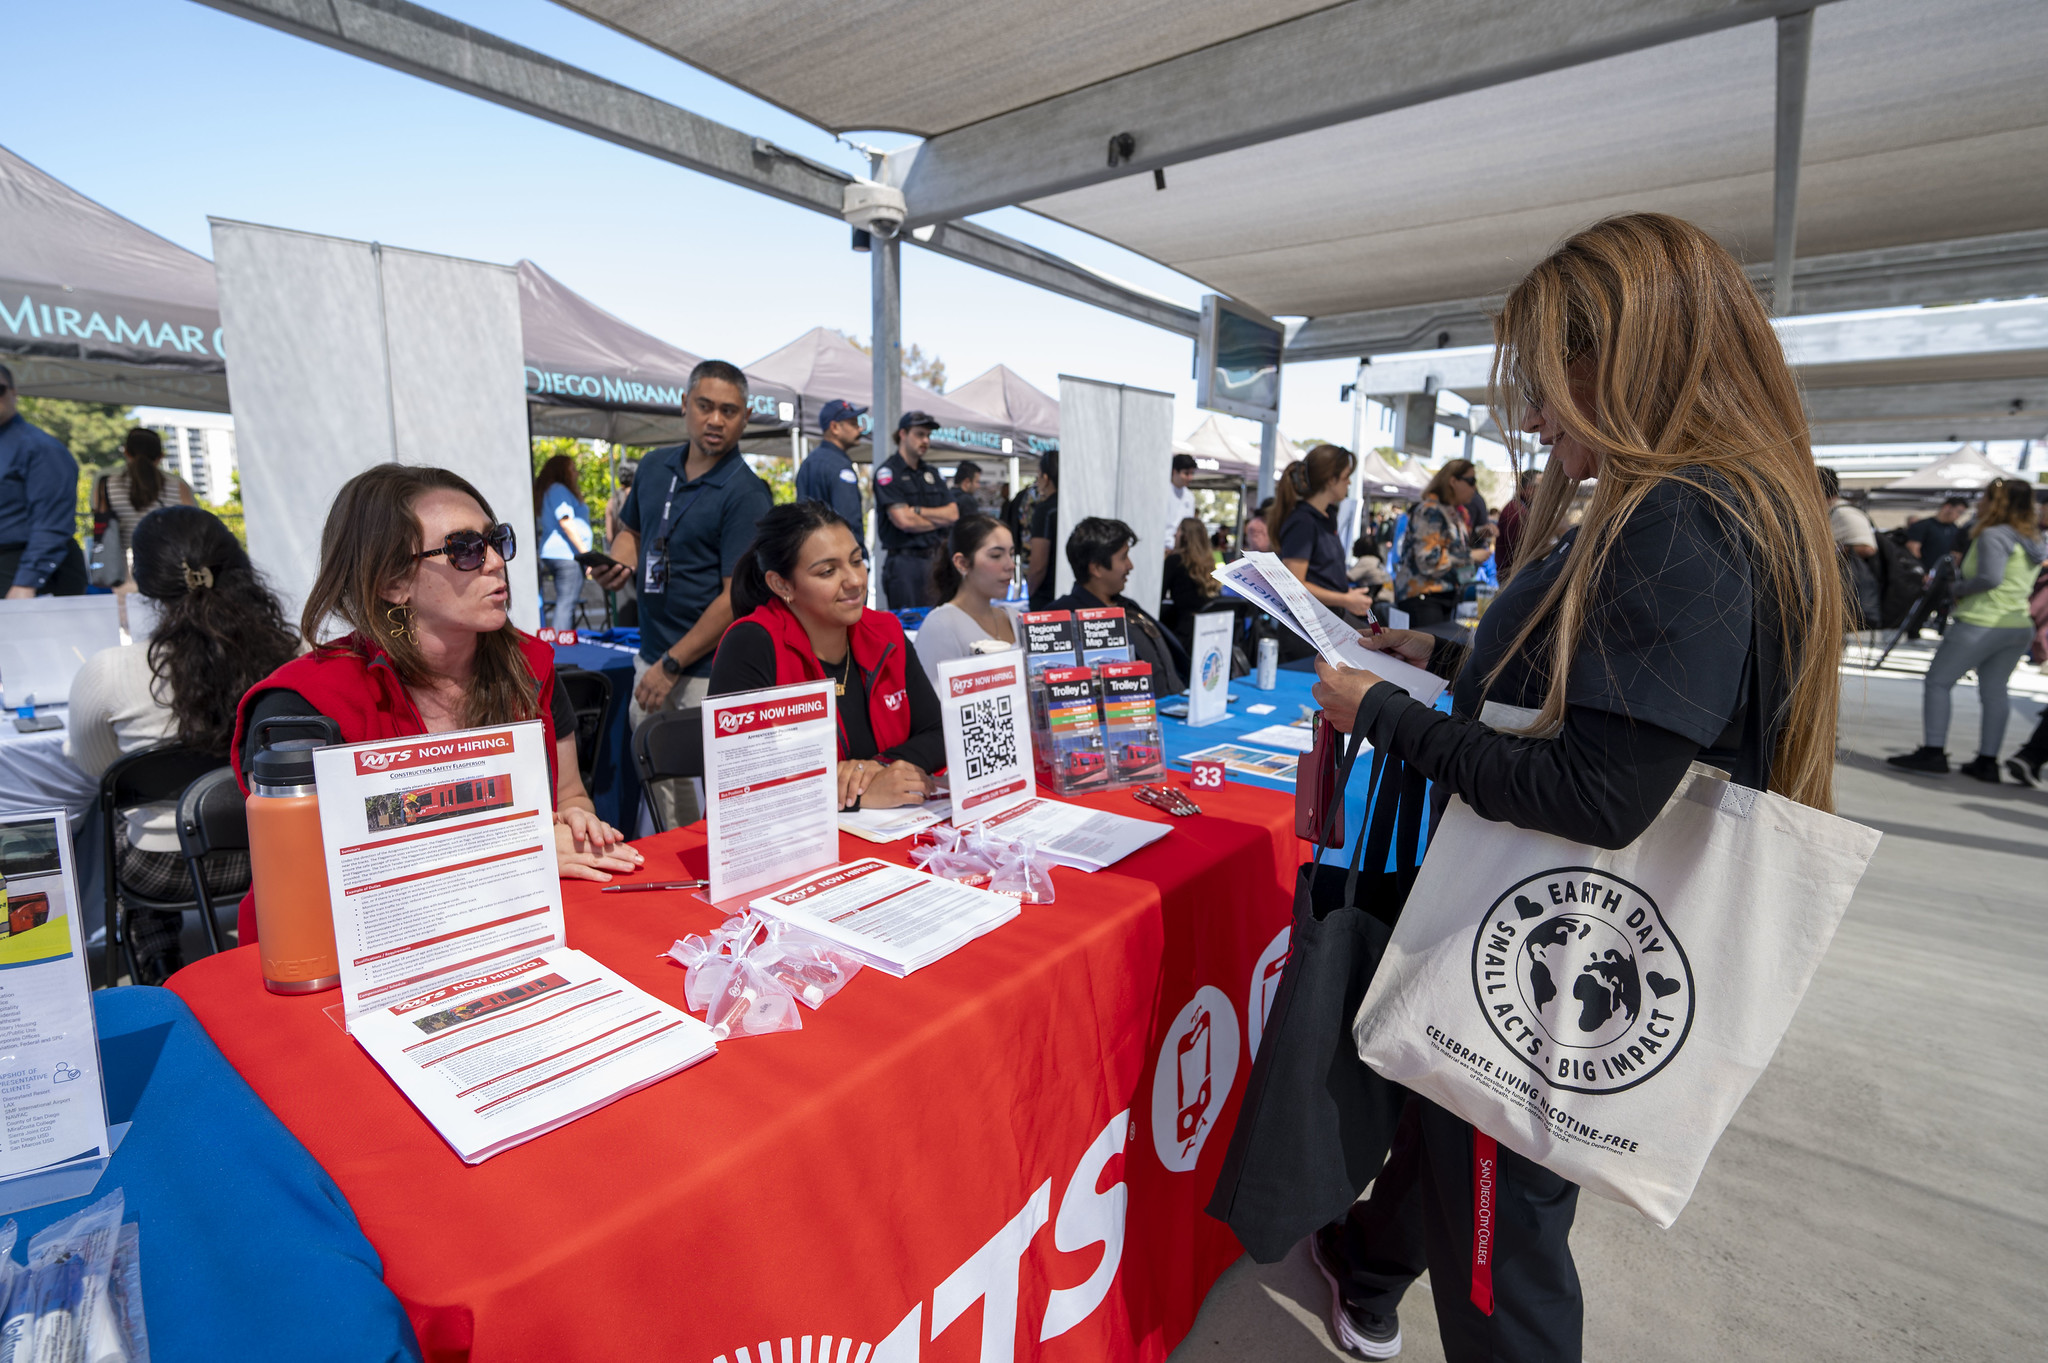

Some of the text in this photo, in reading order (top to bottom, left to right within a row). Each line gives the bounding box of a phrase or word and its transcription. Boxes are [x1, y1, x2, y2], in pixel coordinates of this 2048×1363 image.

[0, 294, 209, 355] MIRAMAR
[524, 366, 685, 405] DIEGO MIRAMA
[957, 425, 1001, 449] COLLEGE
[1028, 623, 1062, 634] Regional
[1083, 619, 1116, 630] Regional
[1084, 629, 1109, 639] Transit
[558, 632, 574, 645] 65
[1029, 633, 1056, 643] Transit
[1031, 642, 1049, 652] Map
[1085, 638, 1103, 647] Map
[975, 676, 990, 686] NOW
[1051, 685, 1080, 697] Trolley
[1110, 680, 1139, 692] Trolley
[719, 700, 824, 730] MTS NOW HIRING.
[361, 737, 509, 768] MTS NOW HIRING.
[389, 760, 486, 779] CONSTRUCTION SAFETY FLAGPERSON
[1194, 766, 1222, 787] 33
[781, 885, 816, 902] MTS
[818, 874, 845, 888] NOW
[1547, 880, 1664, 955] EARTH DAY
[397, 961, 542, 1011] MTS NOW HIRING.
[1484, 920, 1543, 1056] SMALL ACTS
[1558, 1008, 1675, 1081] BIG IMPACT
[0, 1073, 48, 1087] RESENTATIVE
[1, 1084, 31, 1094] CLIENTS
[1426, 1025, 1639, 1153] CELEBRATE LIVING NICOTINE-FREE
[1430, 1041, 1440, 1051] This
[1440, 1047, 1460, 1064] material
[1460, 1061, 1469, 1069] was
[1470, 1066, 1484, 1077] made
[1484, 1075, 1504, 1090] possible
[1511, 1091, 1526, 1102] funds
[1554, 1124, 1563, 1133] the
[1563, 1130, 1590, 1145] California
[1590, 1143, 1623, 1156] Department
[1476, 1076, 1491, 1089] Public
[1491, 1086, 1509, 1101] Health,
[1510, 1097, 1524, 1108] under
[44, 1112, 60, 1120] Diego
[1477, 1158, 1493, 1266] SAN DIEGO CITY COLLEGE
